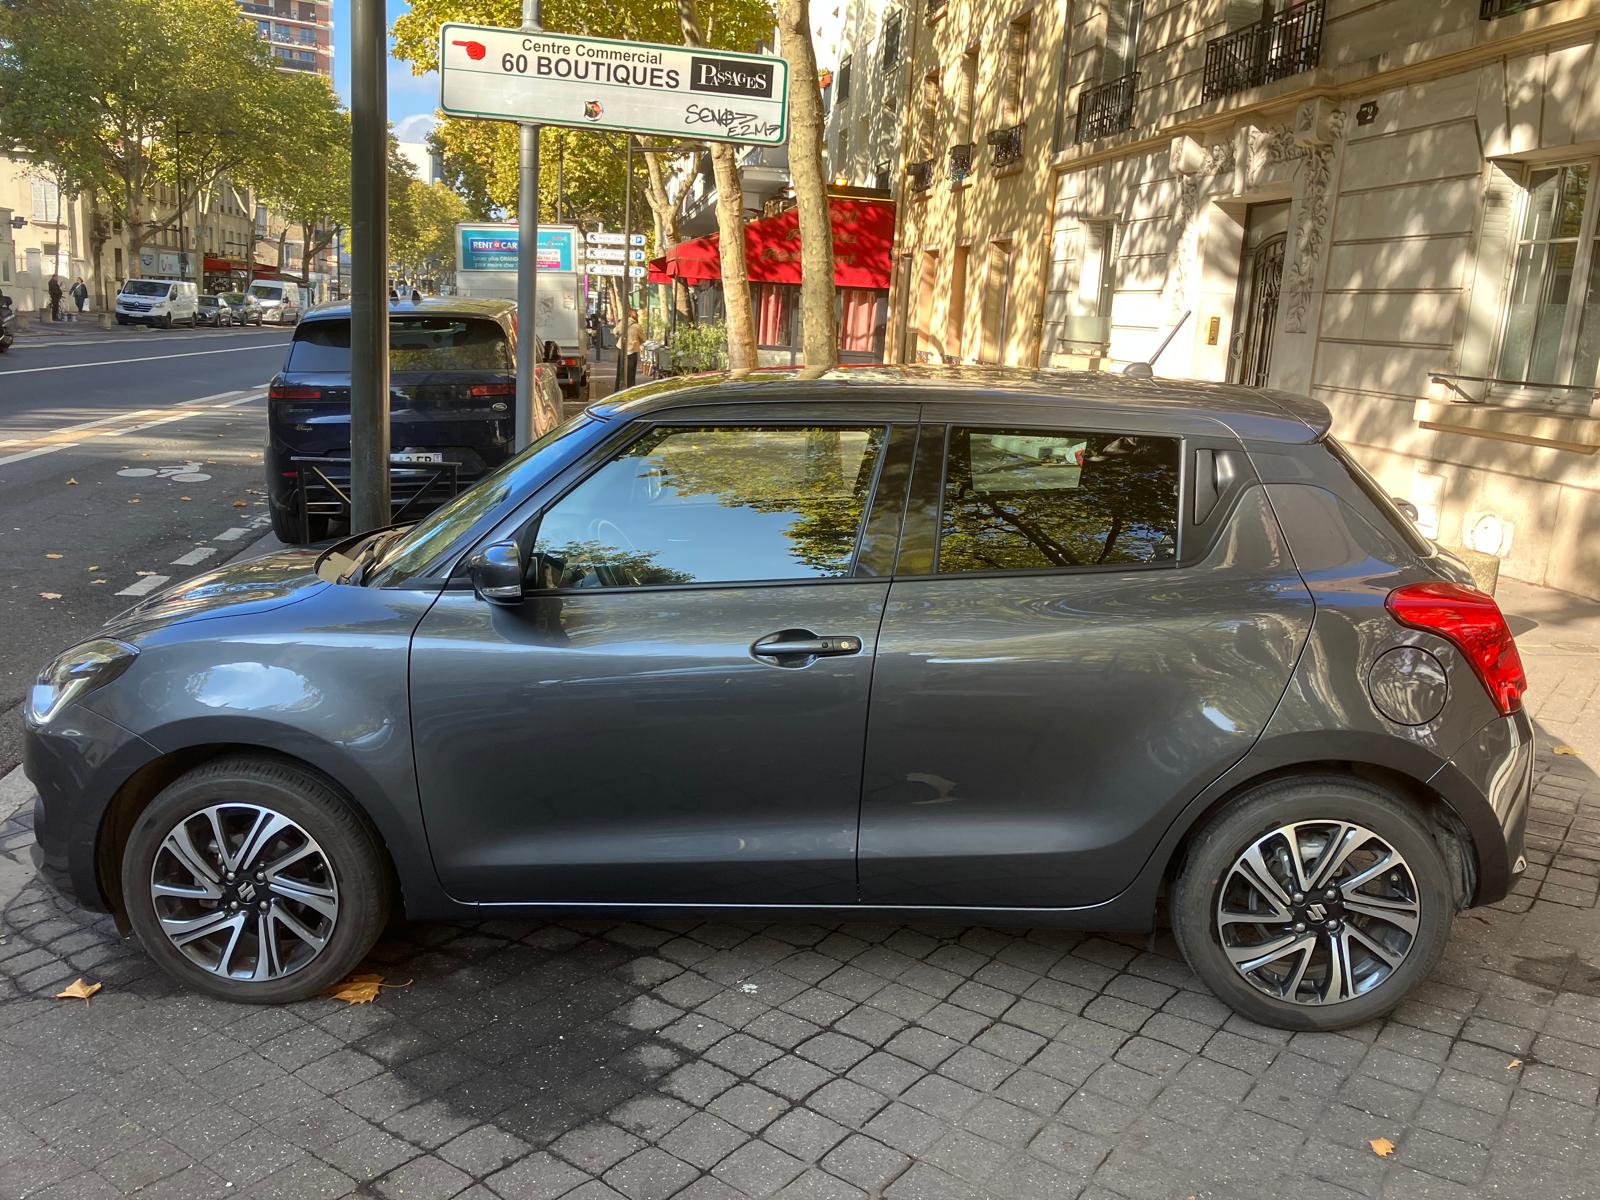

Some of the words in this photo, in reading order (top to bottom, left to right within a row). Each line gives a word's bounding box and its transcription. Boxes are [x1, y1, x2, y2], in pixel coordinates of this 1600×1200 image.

[522, 38, 571, 55] Centre
[576, 44, 663, 65] Commercial
[501, 52, 528, 74] 60
[537, 55, 680, 89] BOUTIQUES
[697, 63, 768, 90] PASSAGES
[472, 241, 493, 249] RENT
